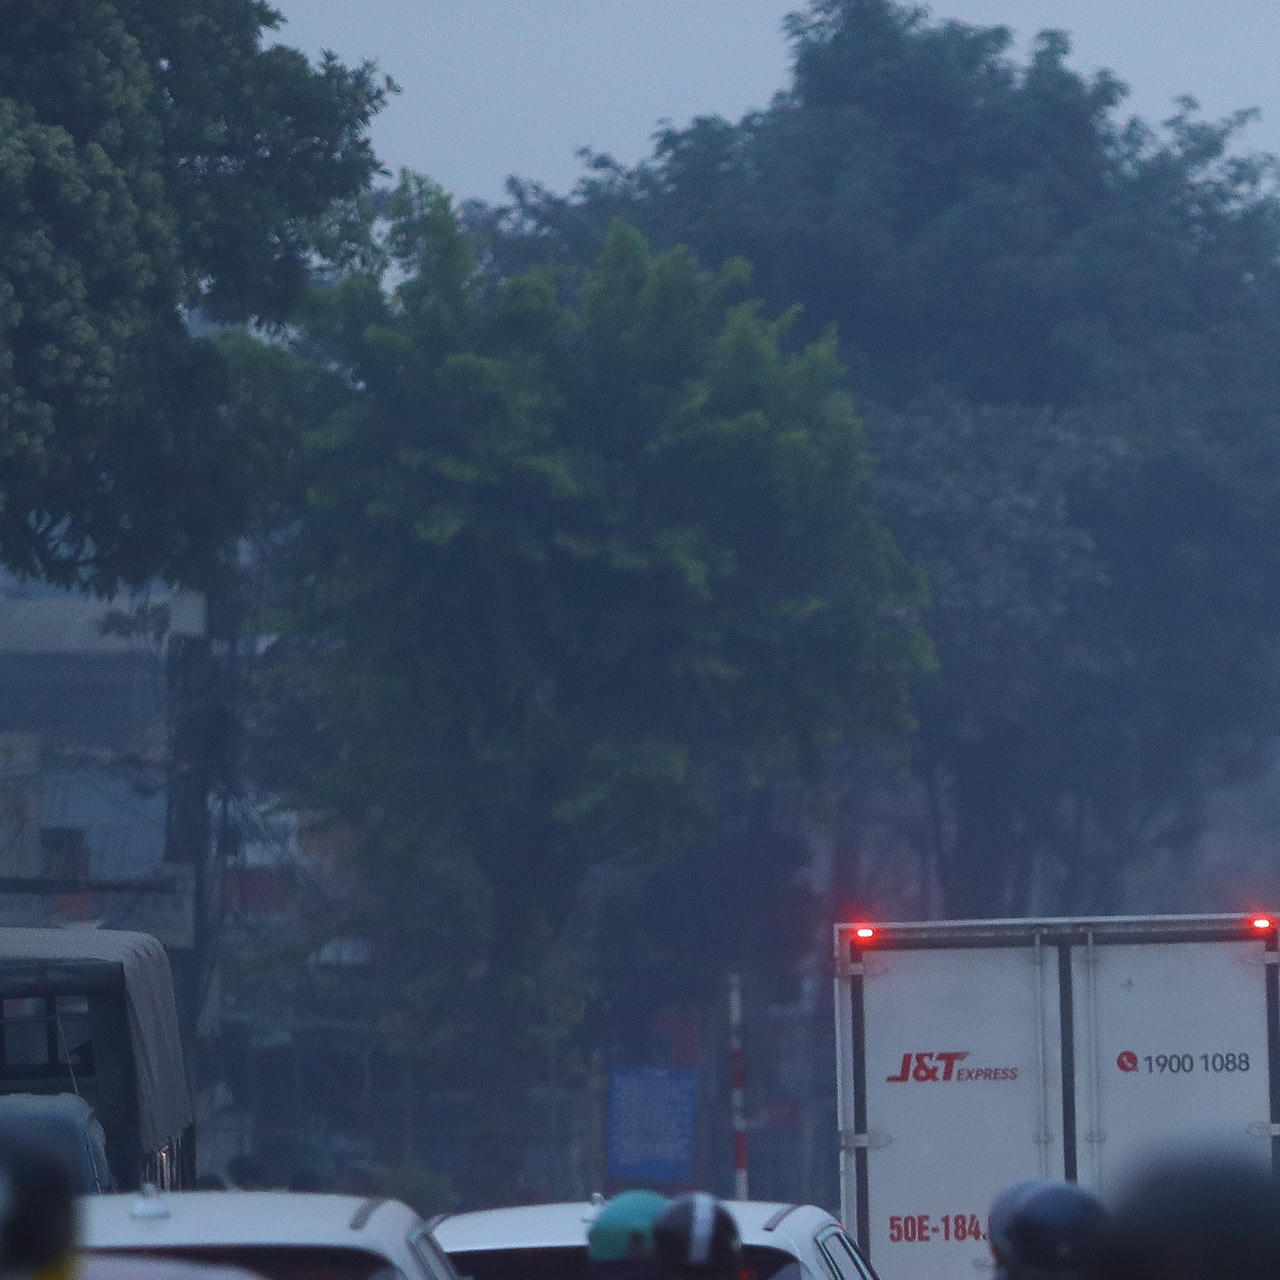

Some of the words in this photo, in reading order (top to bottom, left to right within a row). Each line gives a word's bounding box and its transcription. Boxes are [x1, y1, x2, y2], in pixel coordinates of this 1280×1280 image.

[886, 1051, 970, 1083] J&T
[956, 1066, 1019, 1082] EXPRESS
[1144, 1053, 1194, 1073] 1900
[1201, 1052, 1250, 1072] 1088
